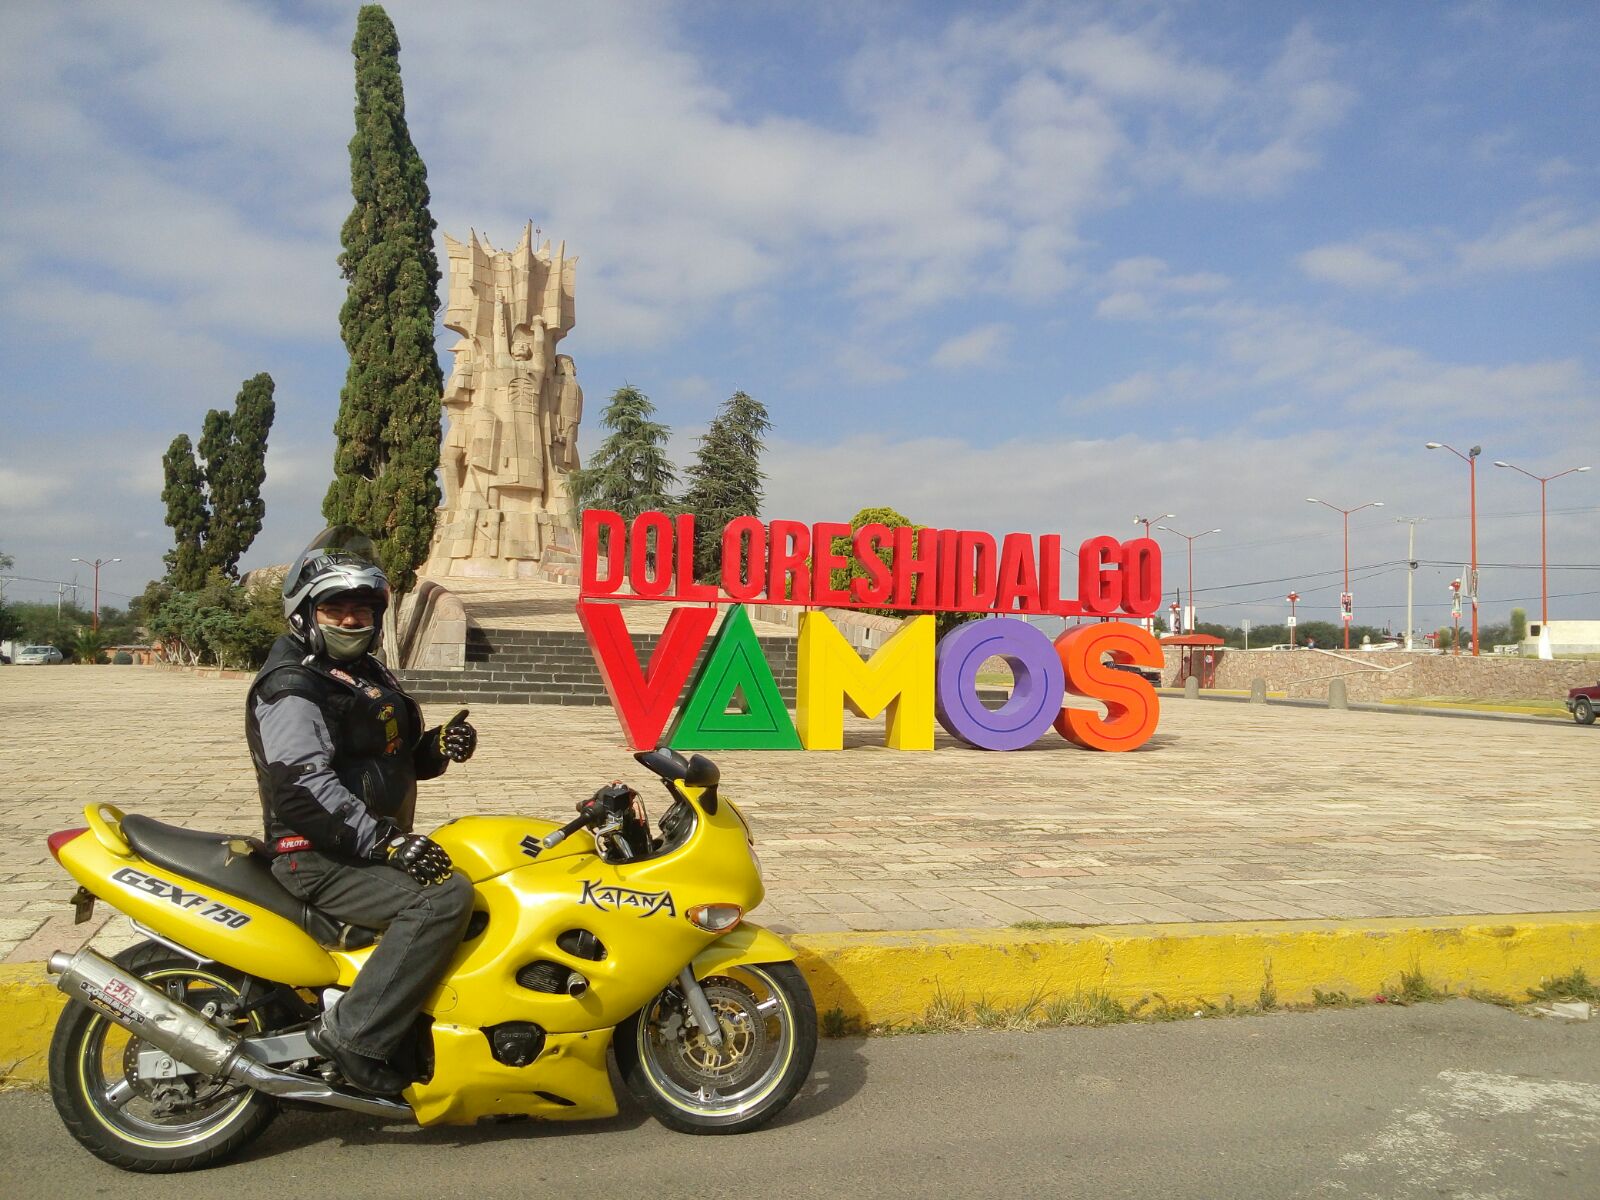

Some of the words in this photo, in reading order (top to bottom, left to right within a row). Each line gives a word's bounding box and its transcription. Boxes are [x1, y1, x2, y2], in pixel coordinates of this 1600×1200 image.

[576, 603, 1164, 752] VAMOS
[200, 903, 252, 929] 750
[576, 877, 676, 918] KATANA
